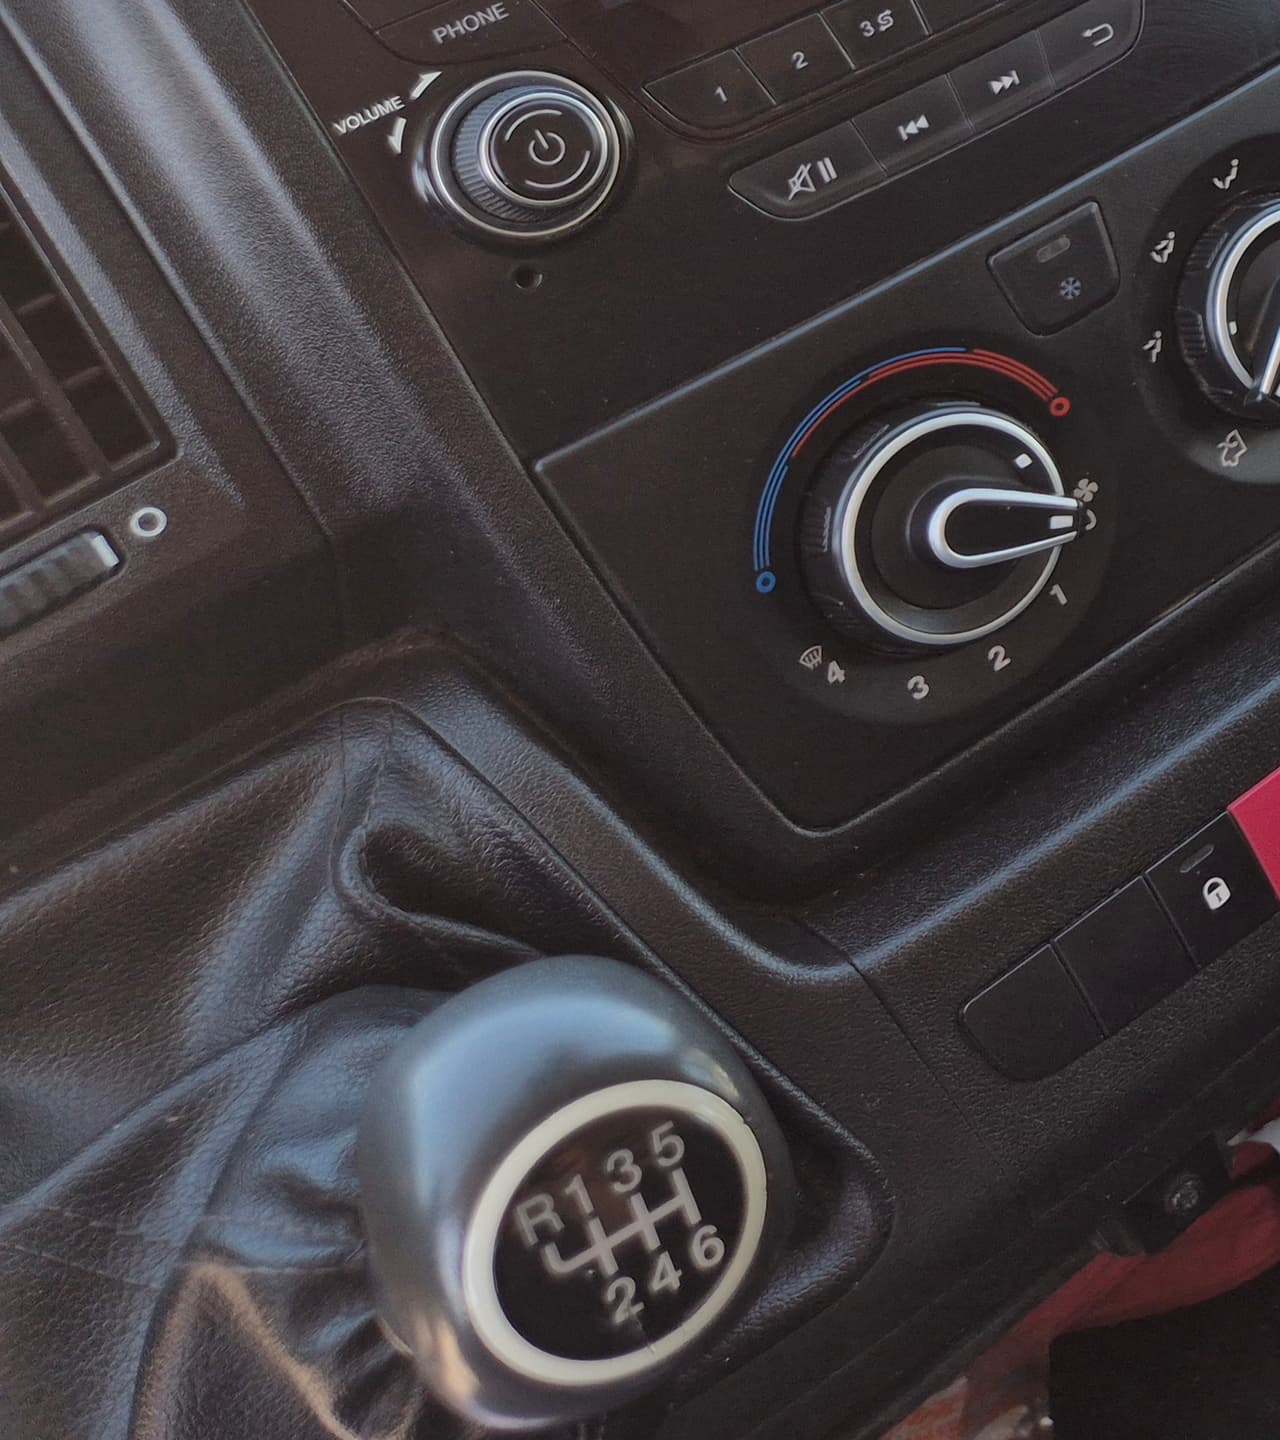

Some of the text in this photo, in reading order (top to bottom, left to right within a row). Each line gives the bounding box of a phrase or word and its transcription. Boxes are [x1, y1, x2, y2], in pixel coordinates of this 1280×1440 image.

[432, 2, 509, 44] PHONE
[860, 20, 875, 37] 3
[792, 51, 808, 69] 2
[714, 85, 729, 103] 1
[334, 95, 406, 136] VOLUME
[1049, 583, 1067, 606] 1
[988, 645, 1011, 672] 2
[827, 661, 846, 684] 4
[907, 675, 929, 700] 3
[515, 1120, 685, 1248] R 1 3 5
[606, 1225, 725, 1324] 2 4 6
